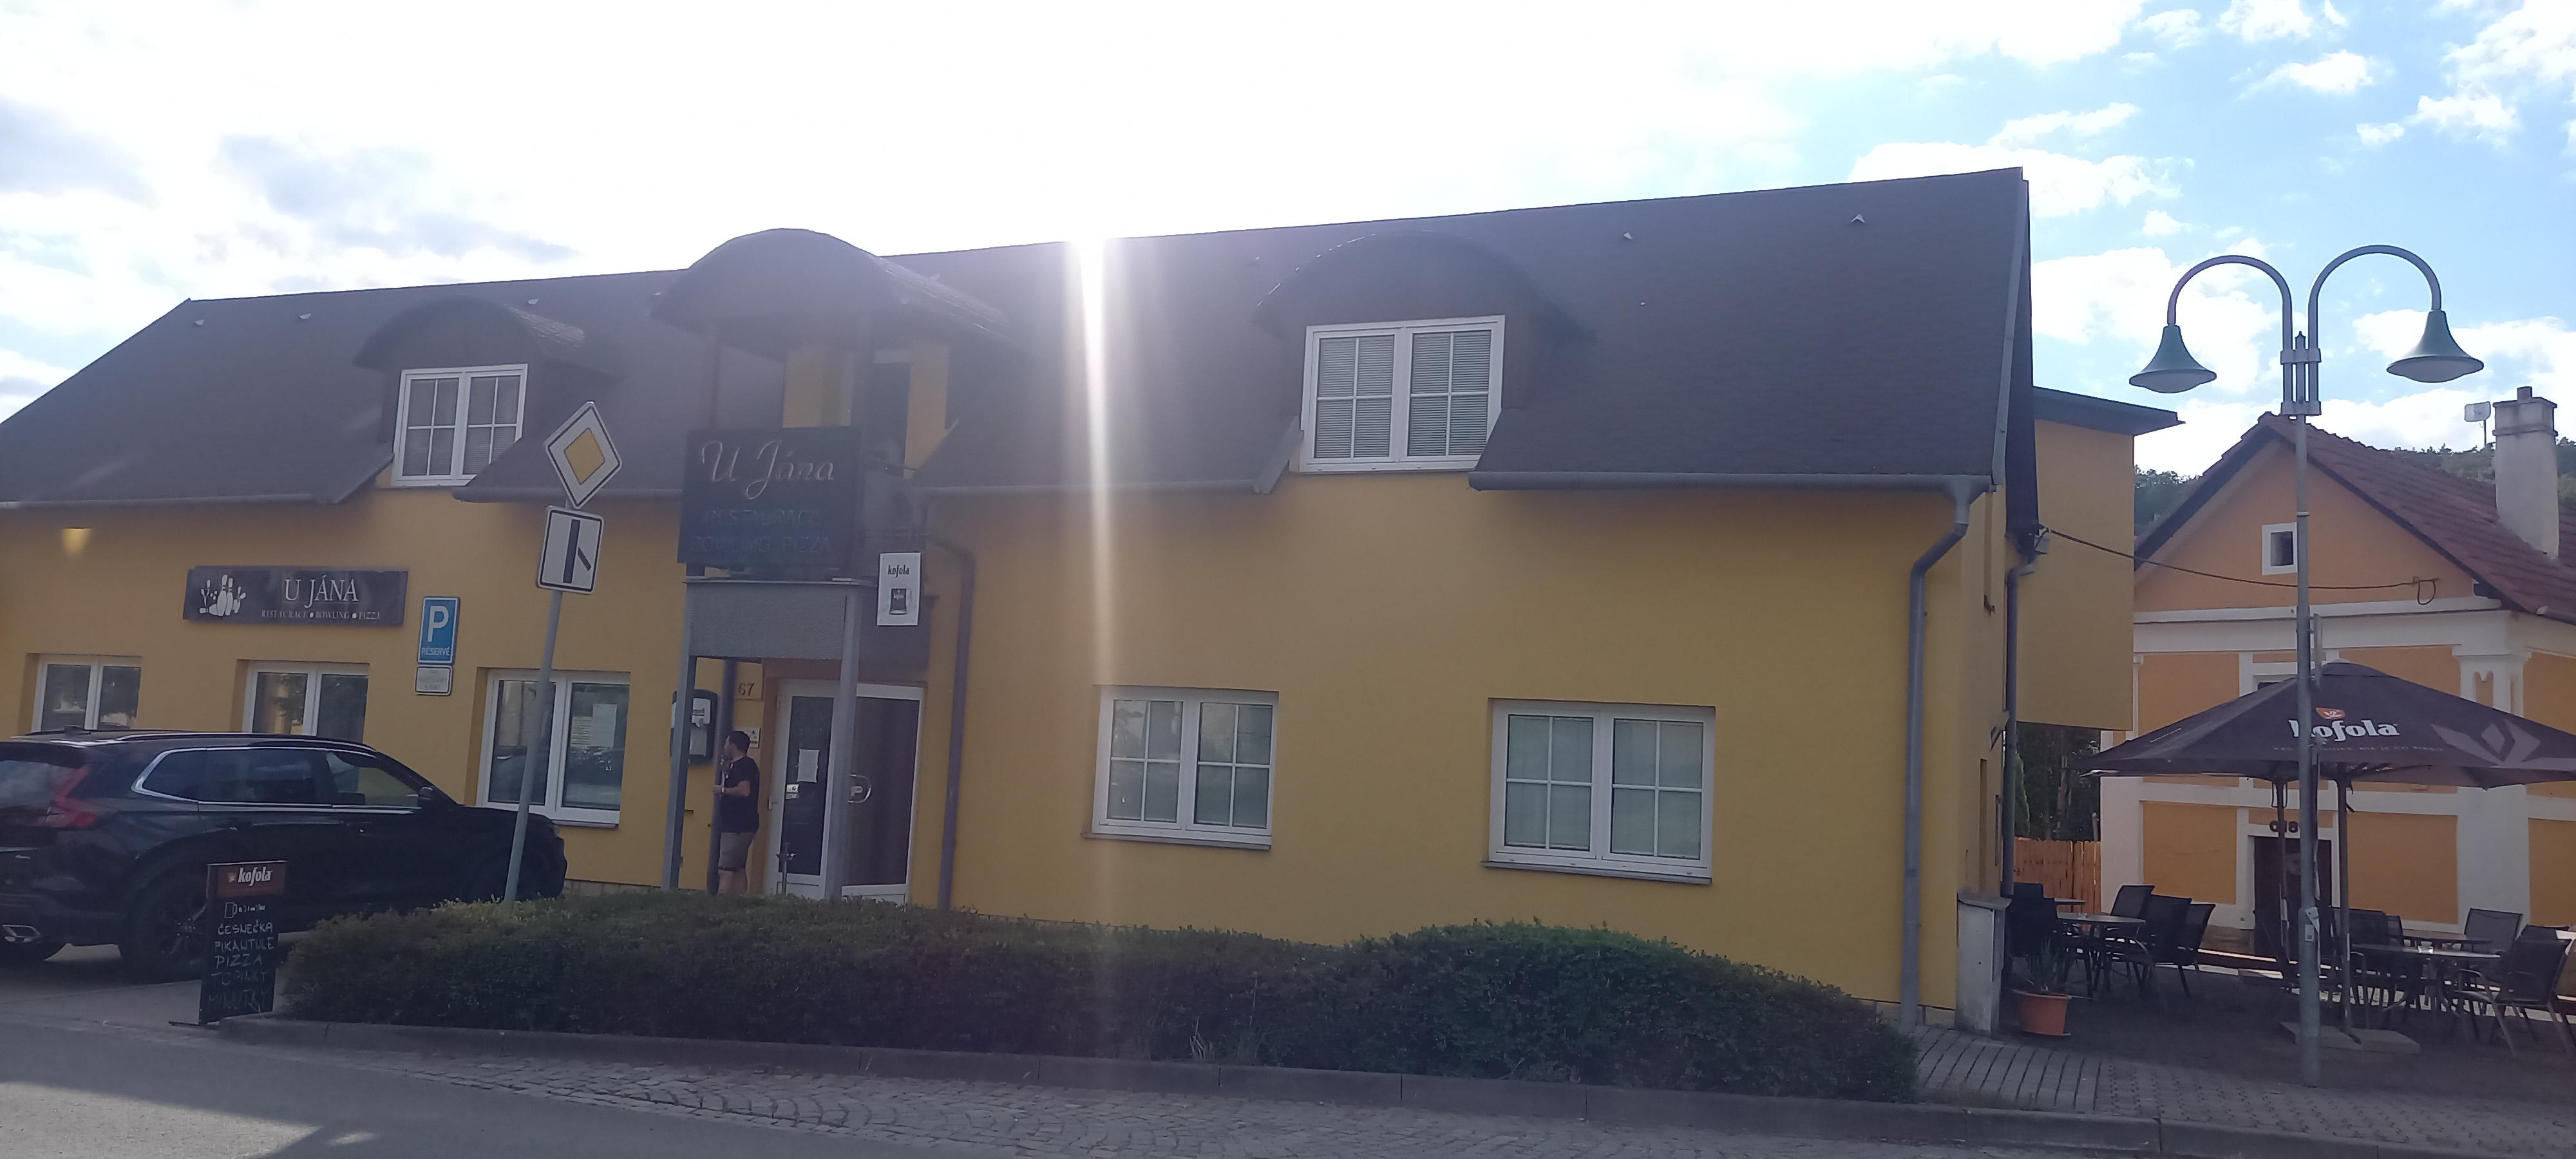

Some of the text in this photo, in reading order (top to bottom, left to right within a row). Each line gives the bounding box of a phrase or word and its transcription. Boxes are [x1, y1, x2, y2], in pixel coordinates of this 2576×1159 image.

[701, 440, 741, 482] U
[887, 564, 909, 578] kofola
[285, 575, 359, 608] U JÁNA
[315, 611, 350, 619] BOWLING
[359, 612, 381, 620] PIZZA
[427, 605, 450, 643] P
[738, 683, 755, 696] 67
[238, 867, 273, 887] kofola
[214, 954, 262, 969] PIZZA
